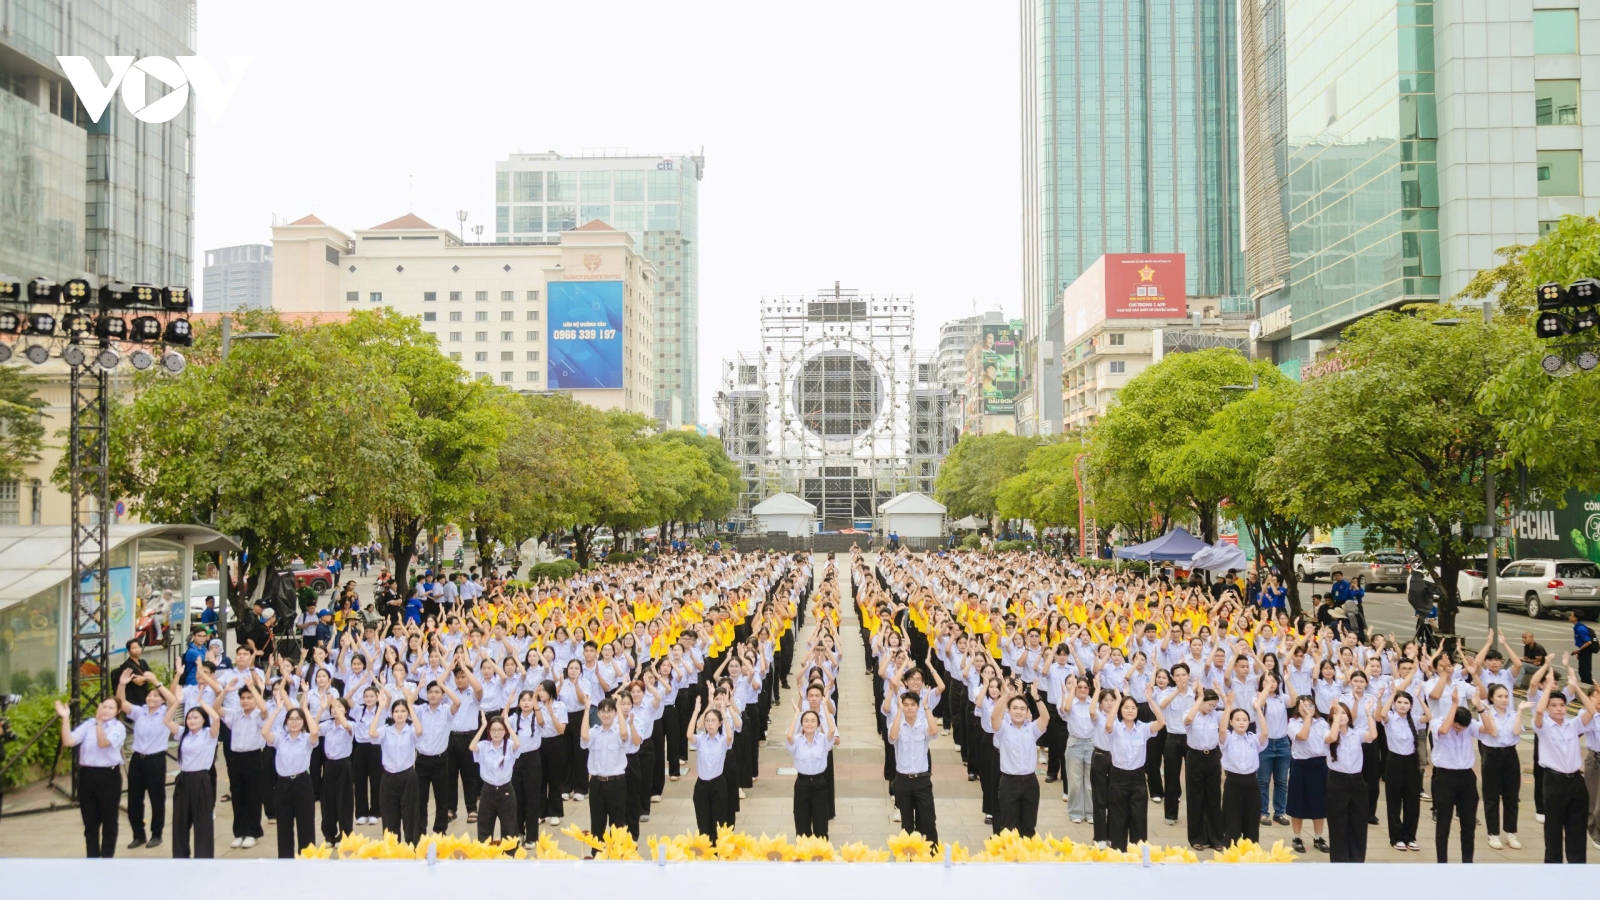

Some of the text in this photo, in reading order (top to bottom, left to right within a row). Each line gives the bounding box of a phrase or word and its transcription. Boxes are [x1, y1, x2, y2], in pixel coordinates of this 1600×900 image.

[657, 159, 673, 170] citi
[554, 330, 616, 340] 0966 339 197
